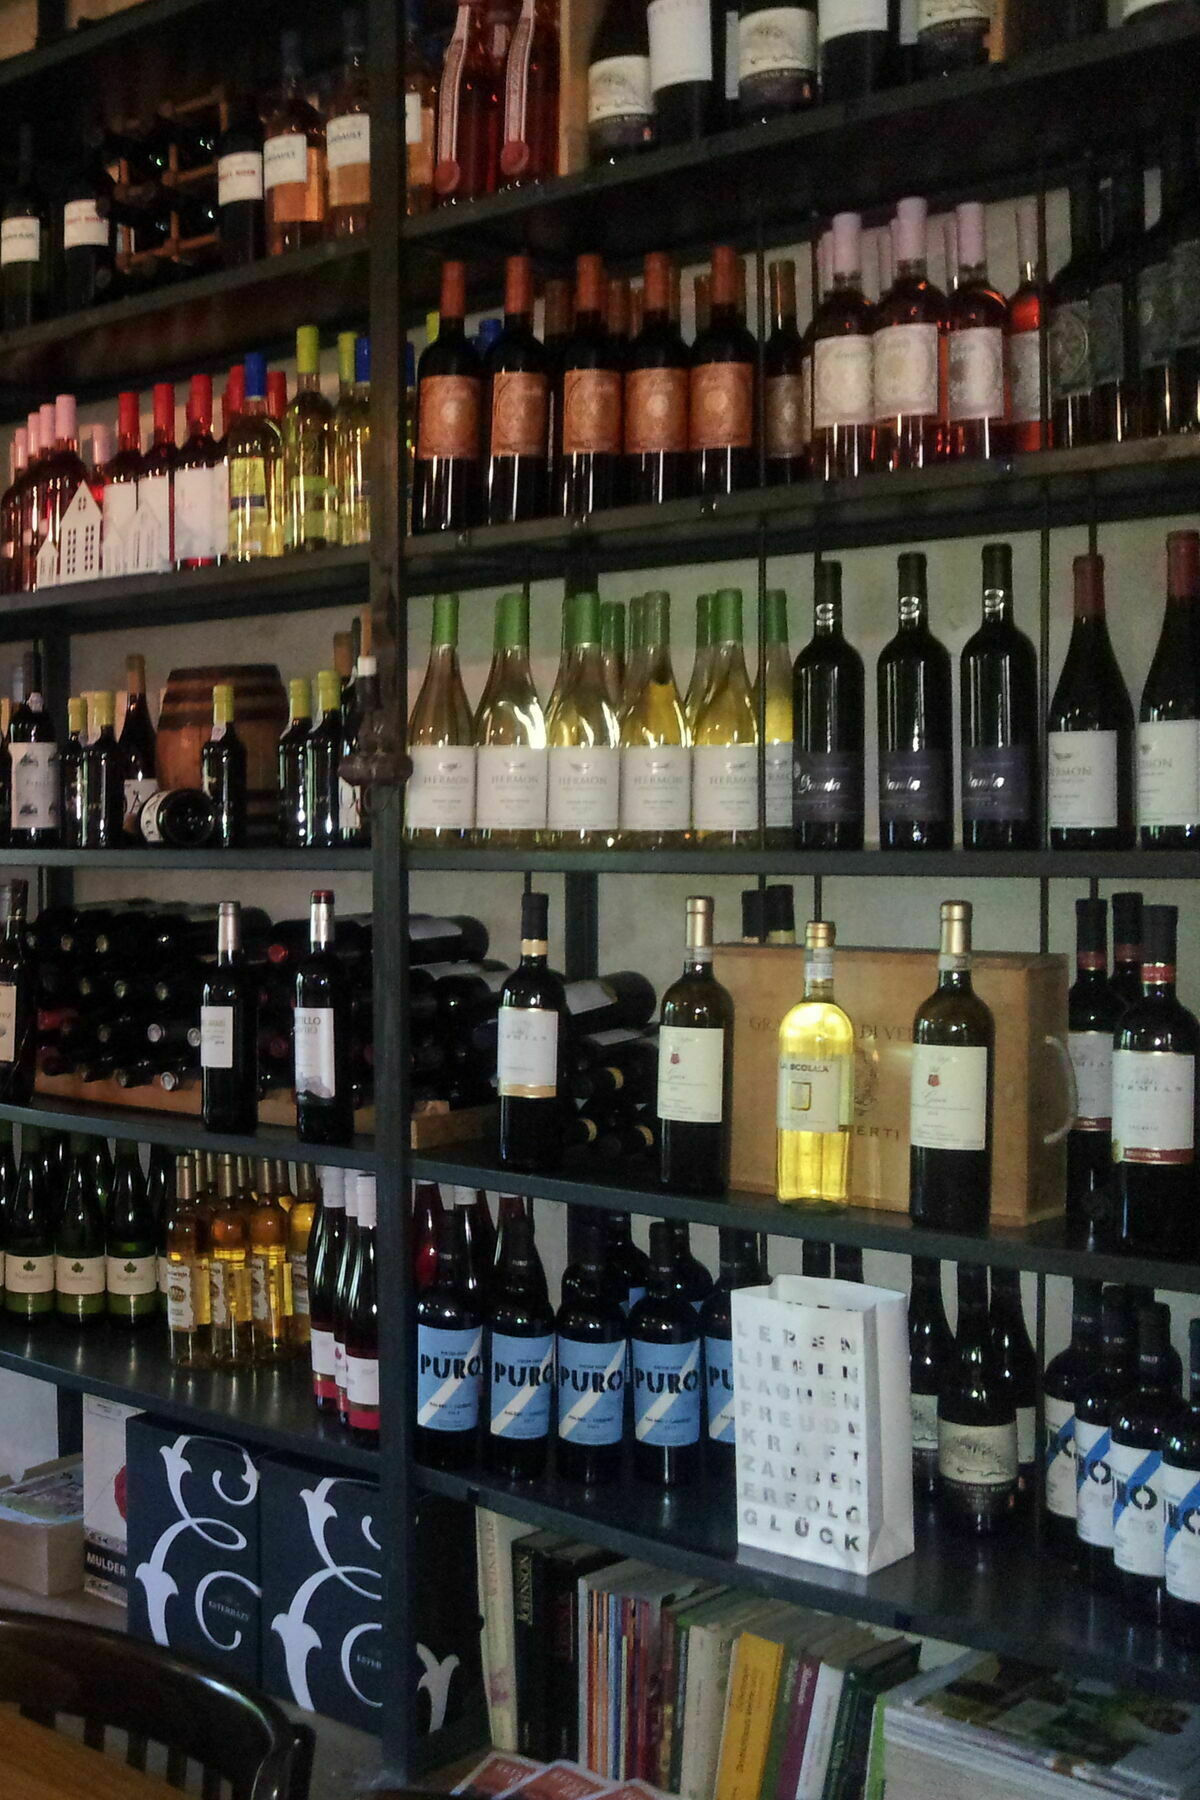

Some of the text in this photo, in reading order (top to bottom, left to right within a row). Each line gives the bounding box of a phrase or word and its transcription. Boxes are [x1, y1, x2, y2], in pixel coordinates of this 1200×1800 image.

[421, 1353, 483, 1380] PURO
[495, 1361, 555, 1388] PURO
[560, 1365, 624, 1393] PURO
[634, 1367, 698, 1394] PURO
[744, 1508, 861, 1552] GLÜCK
[87, 1551, 126, 1577] MULDER
